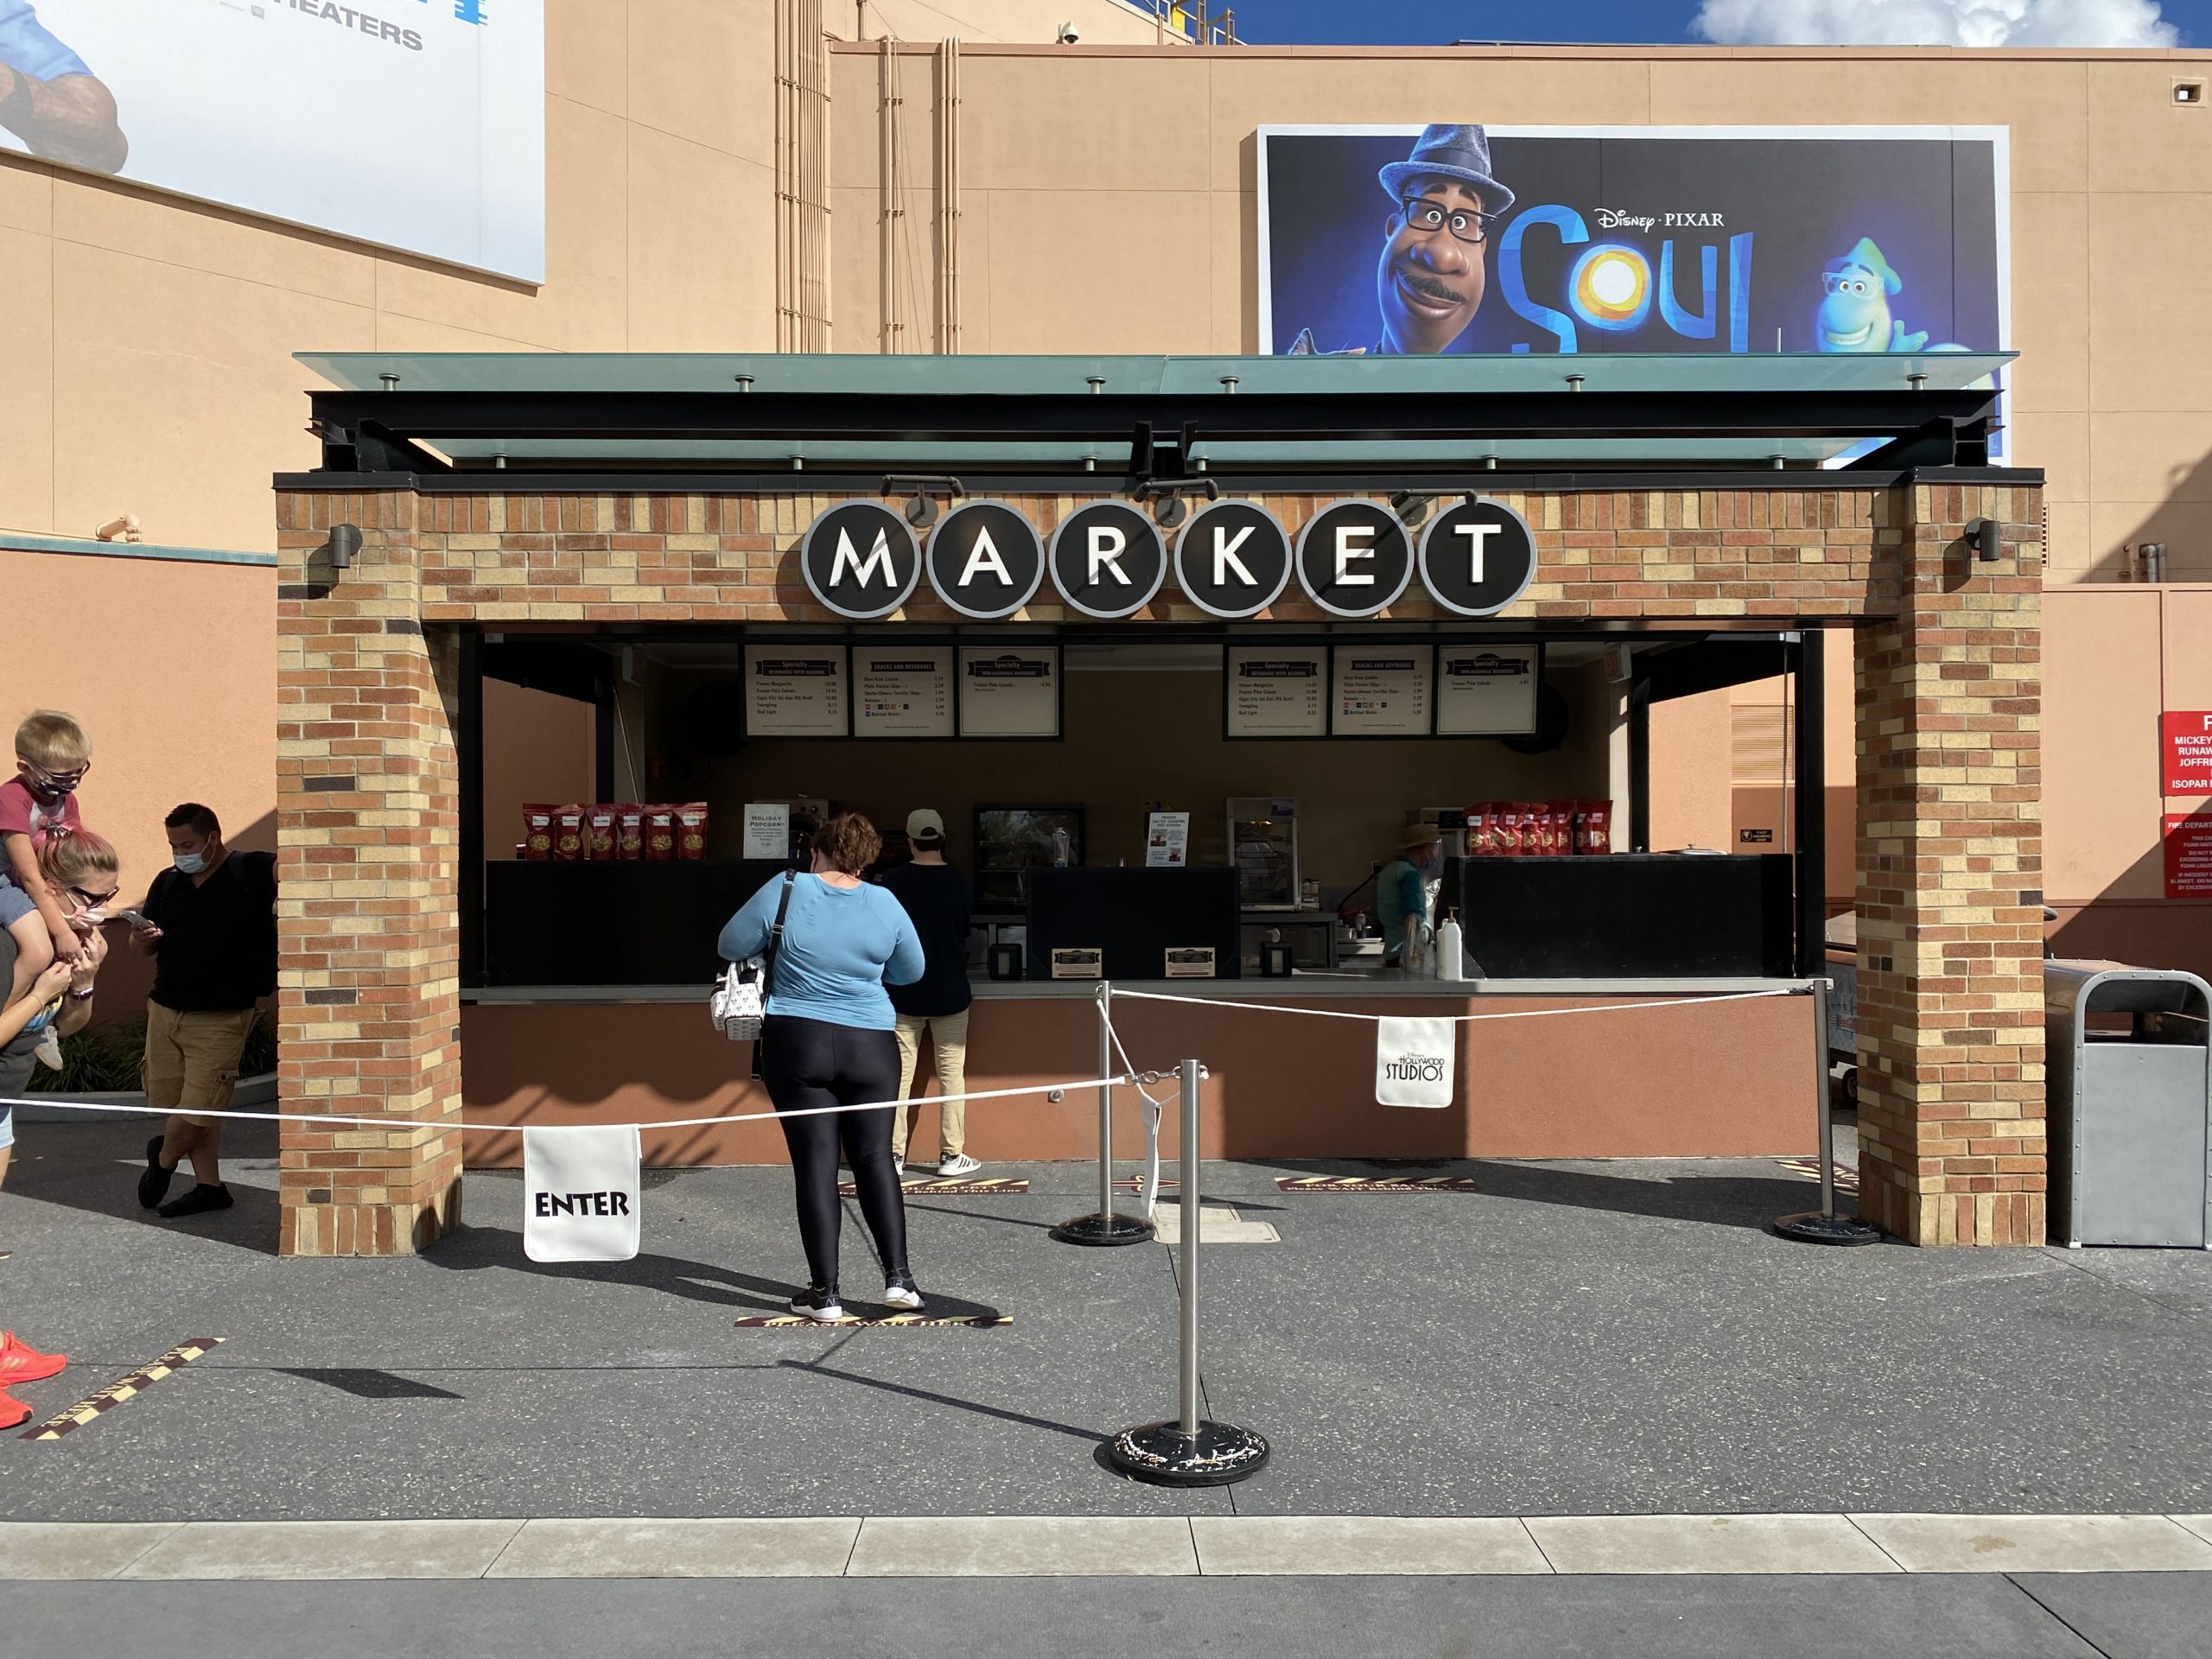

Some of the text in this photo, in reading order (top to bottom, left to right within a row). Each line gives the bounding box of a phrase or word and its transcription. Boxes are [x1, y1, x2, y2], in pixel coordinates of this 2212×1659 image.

[1664, 213, 1725, 227] PIXAR
[827, 523, 1503, 588] MARKET
[2174, 736, 2212, 745] MICKEY
[2171, 779, 2208, 788] ISOPAR
[1398, 1055, 1445, 1065] HOLLYWOOD
[1386, 1063, 1443, 1082] STUDIOS
[535, 1191, 630, 1217] ENTER
[90, 1376, 139, 1400] WAIT
